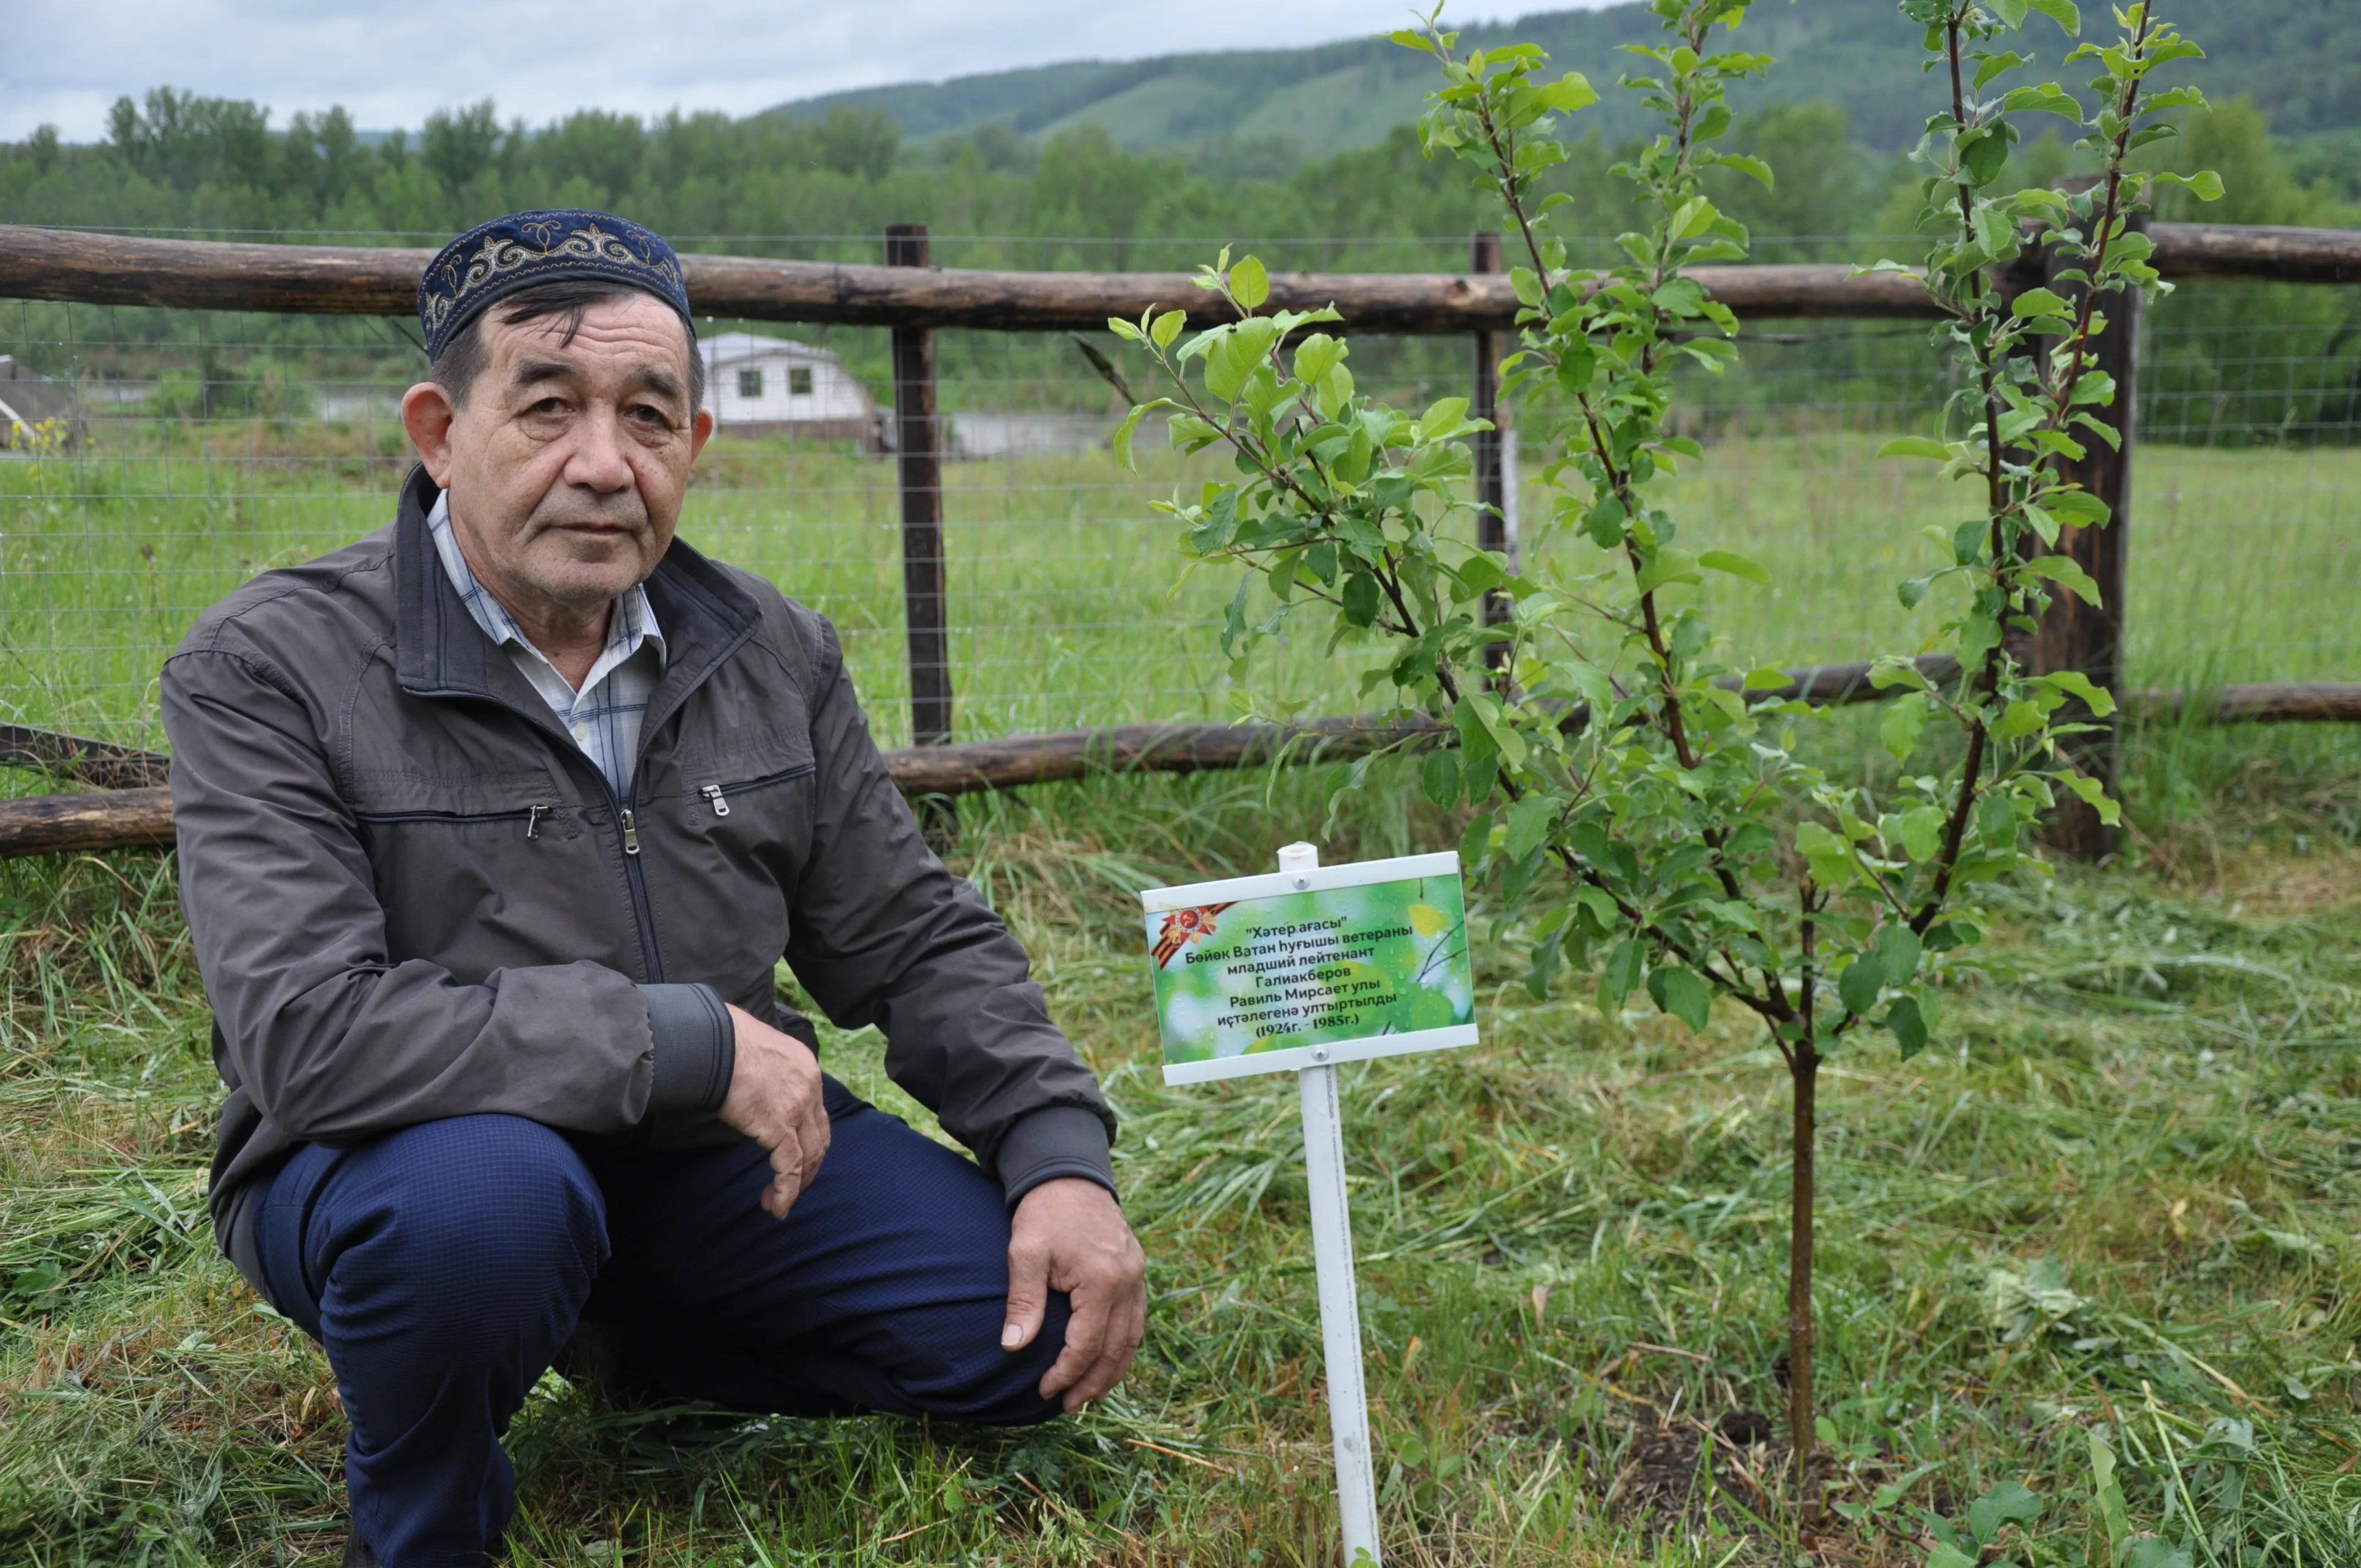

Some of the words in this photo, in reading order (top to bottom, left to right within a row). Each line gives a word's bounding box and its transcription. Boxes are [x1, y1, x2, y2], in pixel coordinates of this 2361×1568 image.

[1246, 925, 1296, 938] "Хәтер
[1299, 916, 1347, 932] ағасы"
[1185, 950, 1231, 963] Бөйөк
[1233, 944, 1276, 957] Ватан
[1279, 937, 1339, 954] һуғышы
[1342, 926, 1412, 942] ветераны
[1228, 955, 1295, 974] младший
[1299, 948, 1375, 966] лейтенант
[1255, 968, 1351, 988] Галиакберов
[1230, 993, 1282, 1008] Равиль
[1285, 984, 1348, 1000] Мирсает
[1351, 980, 1380, 995] улы
[1217, 1008, 1299, 1028] иҫтәлегенә
[1302, 994, 1397, 1017] ултыртылды
[1313, 1014, 1359, 1030] 1985г.)
